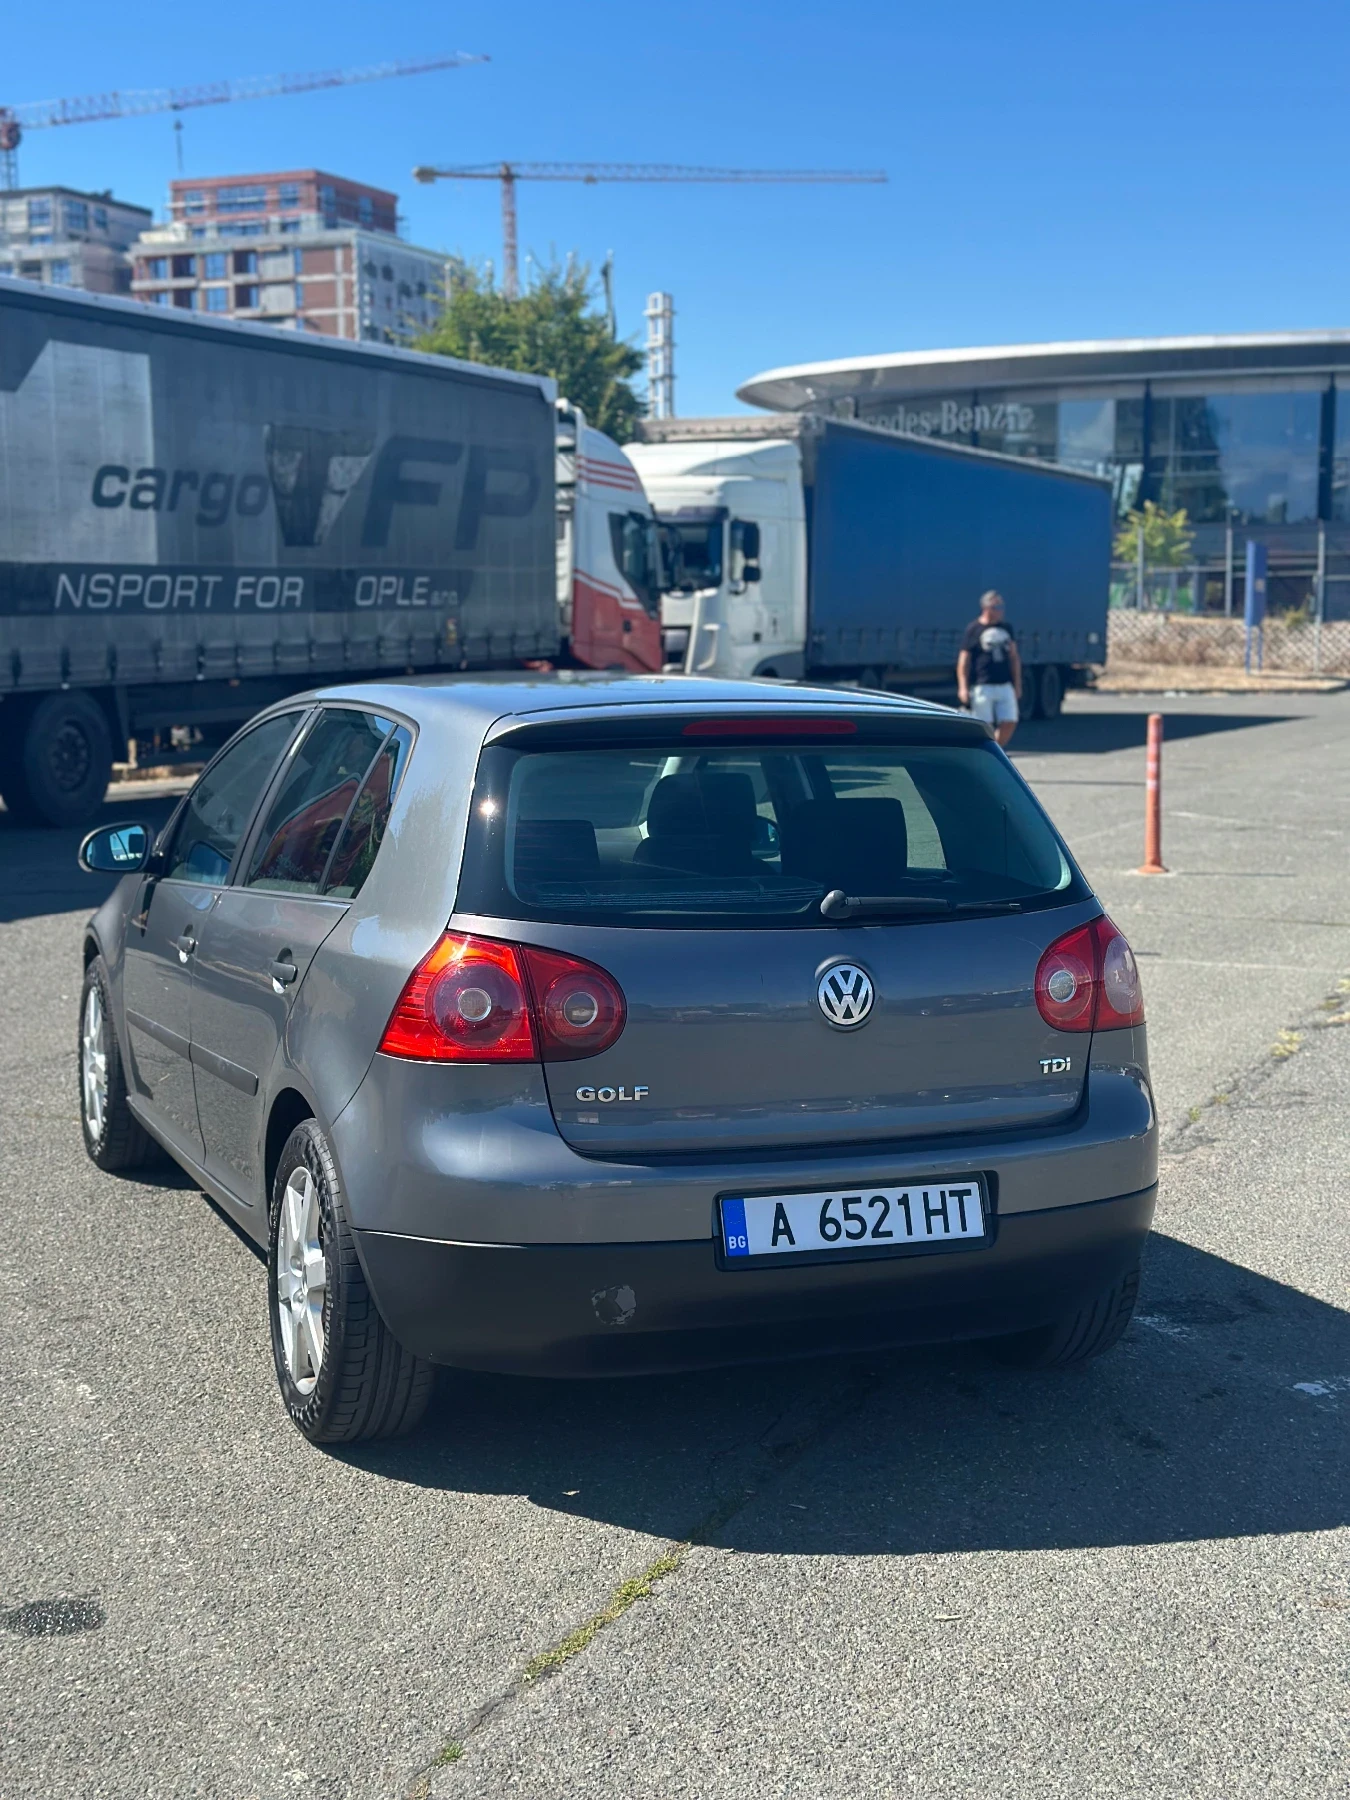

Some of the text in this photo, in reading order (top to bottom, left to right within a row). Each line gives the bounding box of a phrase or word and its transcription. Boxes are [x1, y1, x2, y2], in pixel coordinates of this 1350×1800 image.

[868, 400, 1007, 435] edes-Benz
[91, 464, 269, 527] cargo
[55, 573, 223, 609] NSPORT
[234, 576, 304, 608] FOR
[355, 576, 430, 606] OPLE
[576, 1086, 649, 1102] GOLF
[771, 1202, 796, 1247] A
[728, 1235, 746, 1250] BG
